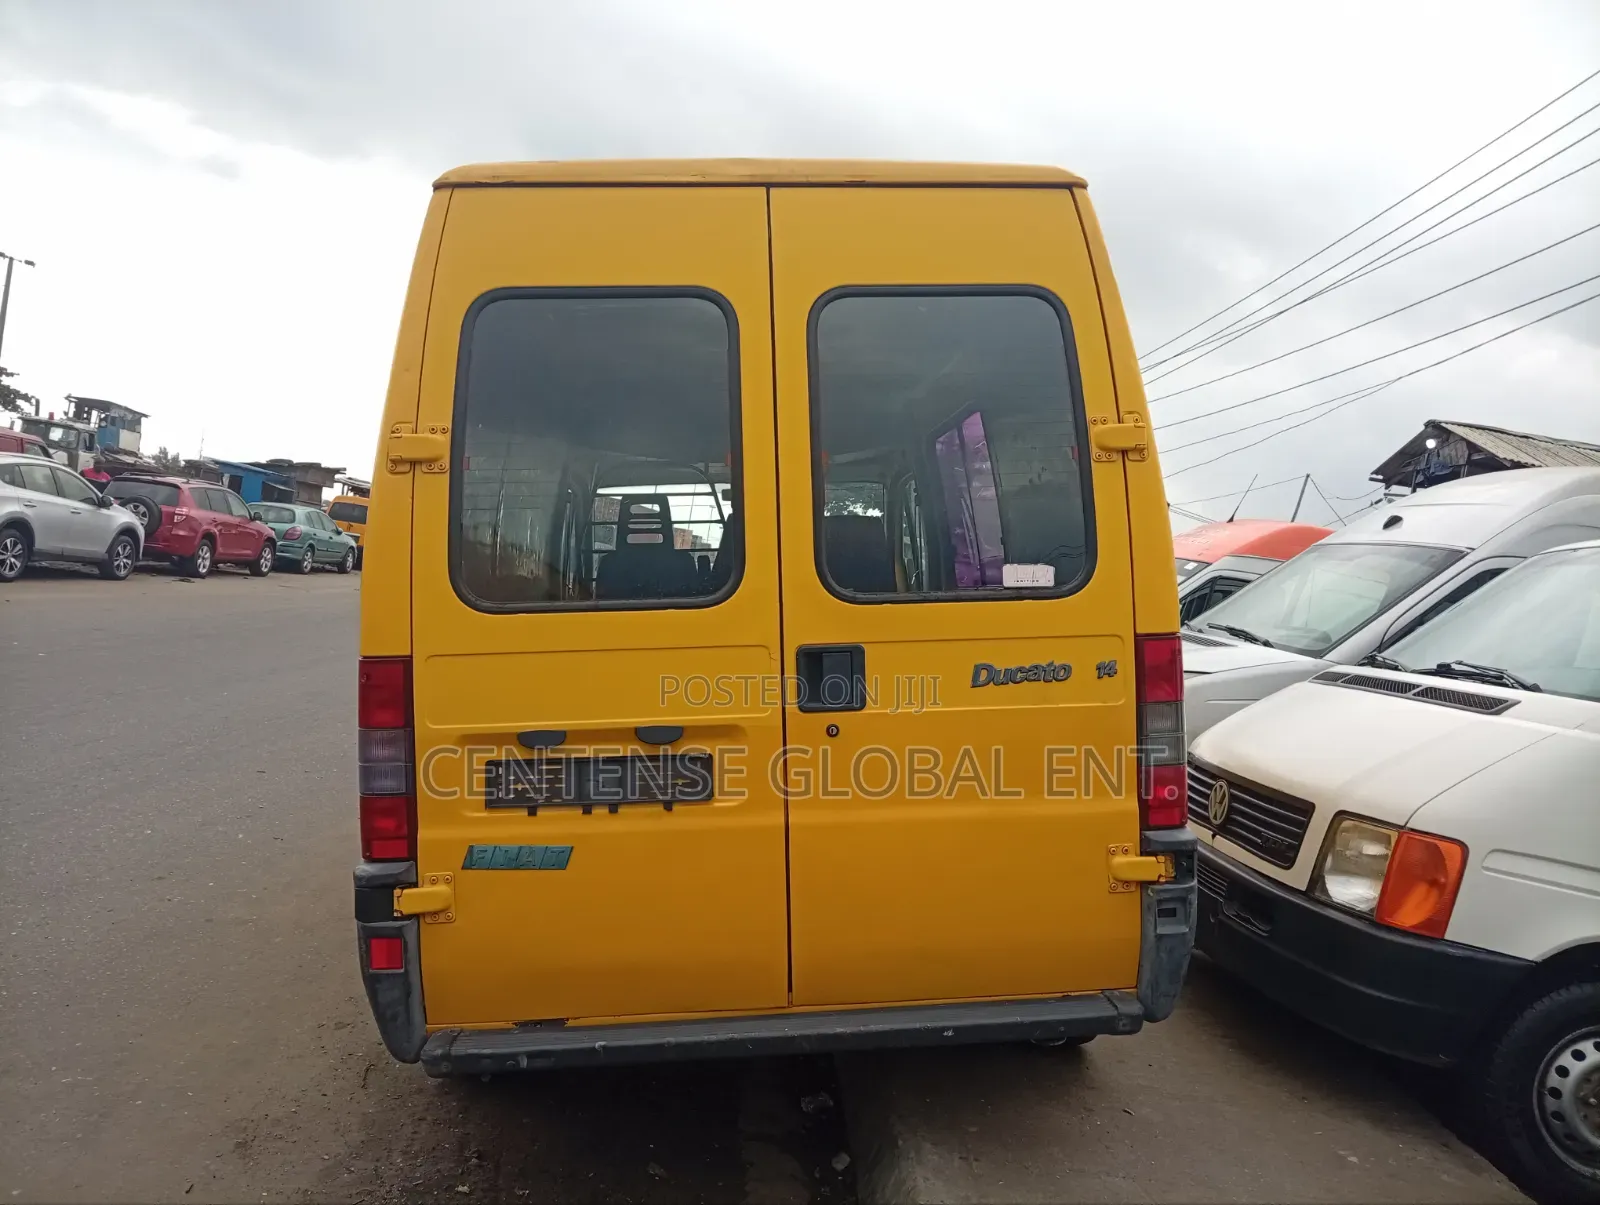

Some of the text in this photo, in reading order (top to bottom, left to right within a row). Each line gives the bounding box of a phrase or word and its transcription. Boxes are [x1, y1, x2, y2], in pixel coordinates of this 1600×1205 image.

[970, 660, 1118, 688] Ducato 14
[465, 844, 571, 870] FIAT
